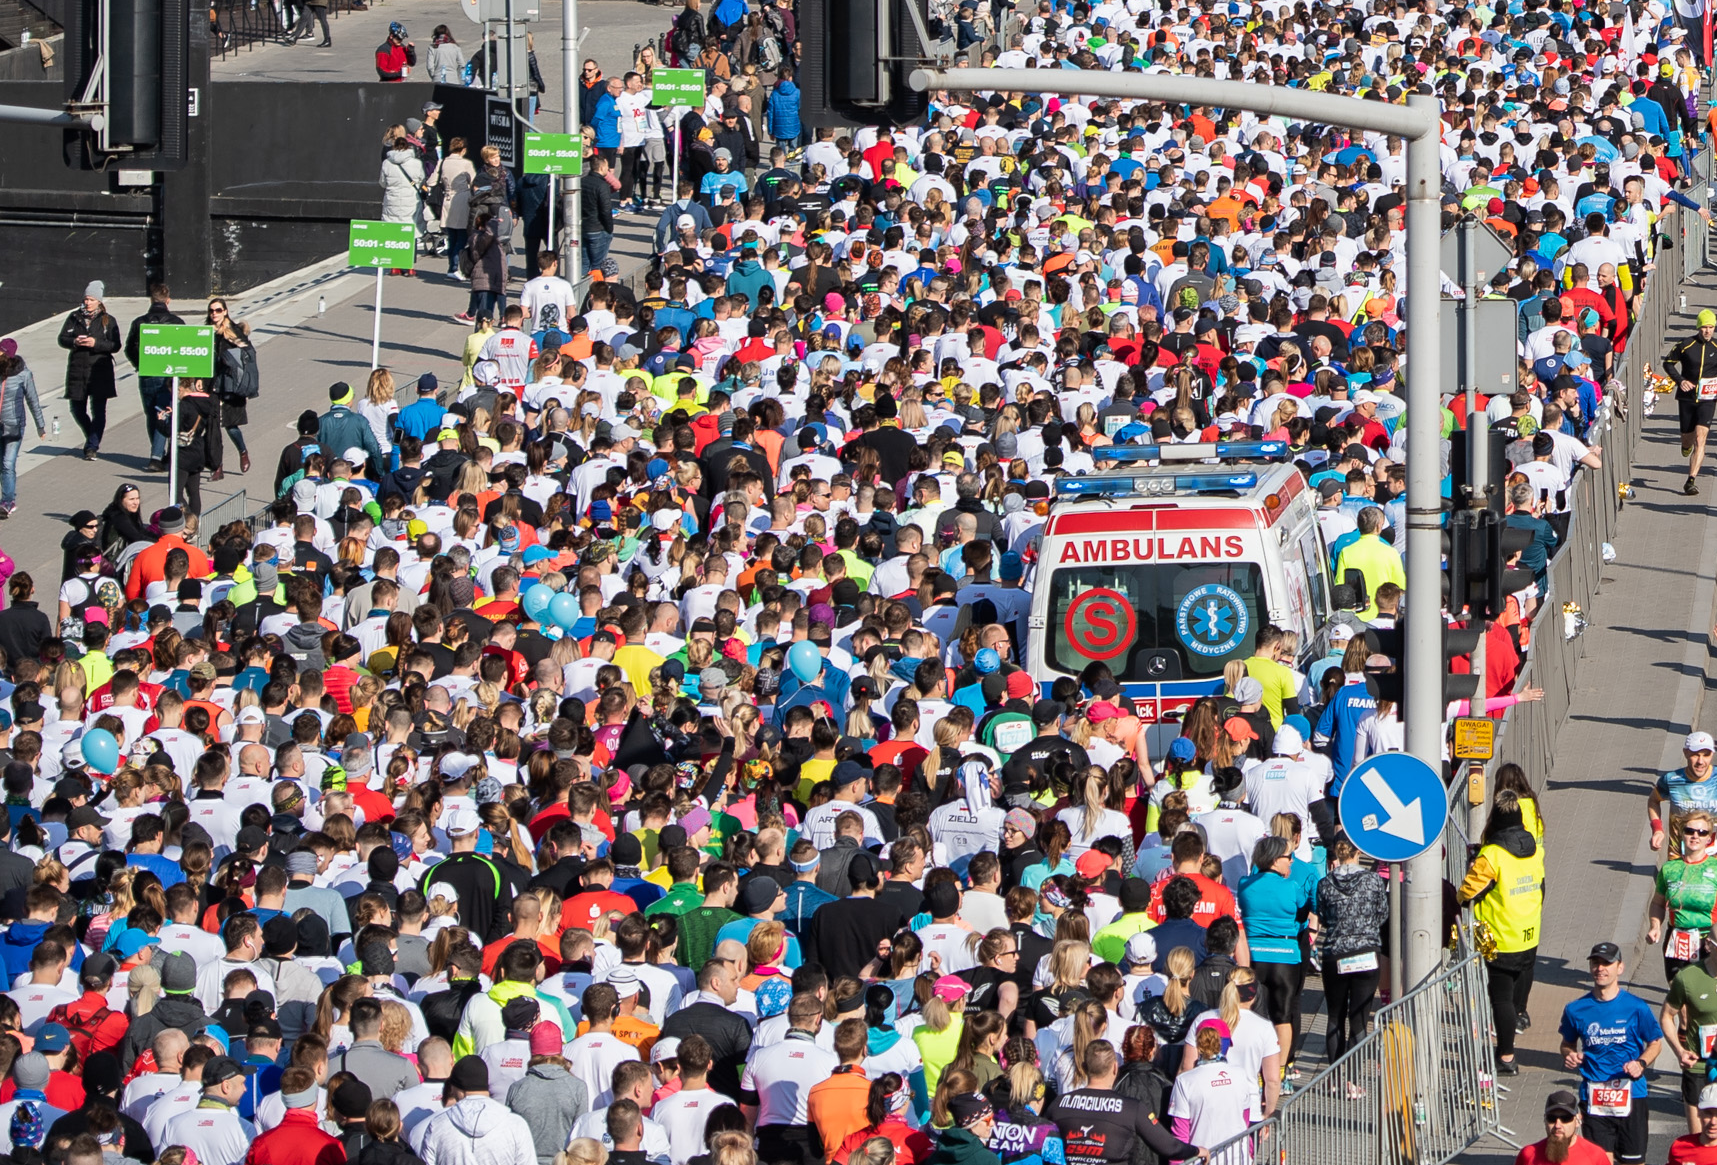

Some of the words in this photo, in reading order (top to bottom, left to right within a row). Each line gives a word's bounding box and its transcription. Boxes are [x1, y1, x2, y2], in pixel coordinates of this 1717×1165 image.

[353, 239, 378, 248] 50:01
[385, 240, 411, 250] 55:00
[144, 346, 172, 355] 50:01
[180, 347, 208, 356] 55:00
[1059, 535, 1244, 564] AMBULANS
[1178, 587, 1207, 636] PAŃSTWOWE
[1216, 586, 1247, 634] RATOWNICTWO
[1083, 602, 1118, 647] S
[1190, 639, 1237, 654] MEDYCZNE
[1193, 902, 1215, 914] EAM
[1522, 926, 1535, 942] 767
[1600, 1027, 1626, 1035] Markowi
[1590, 1035, 1627, 1046] Biegacze
[1059, 1094, 1122, 1112] M.MACIUKAS
[1597, 1091, 1624, 1103] 3592
[990, 1122, 1038, 1144] NTON
[989, 1138, 1025, 1153] EAM
